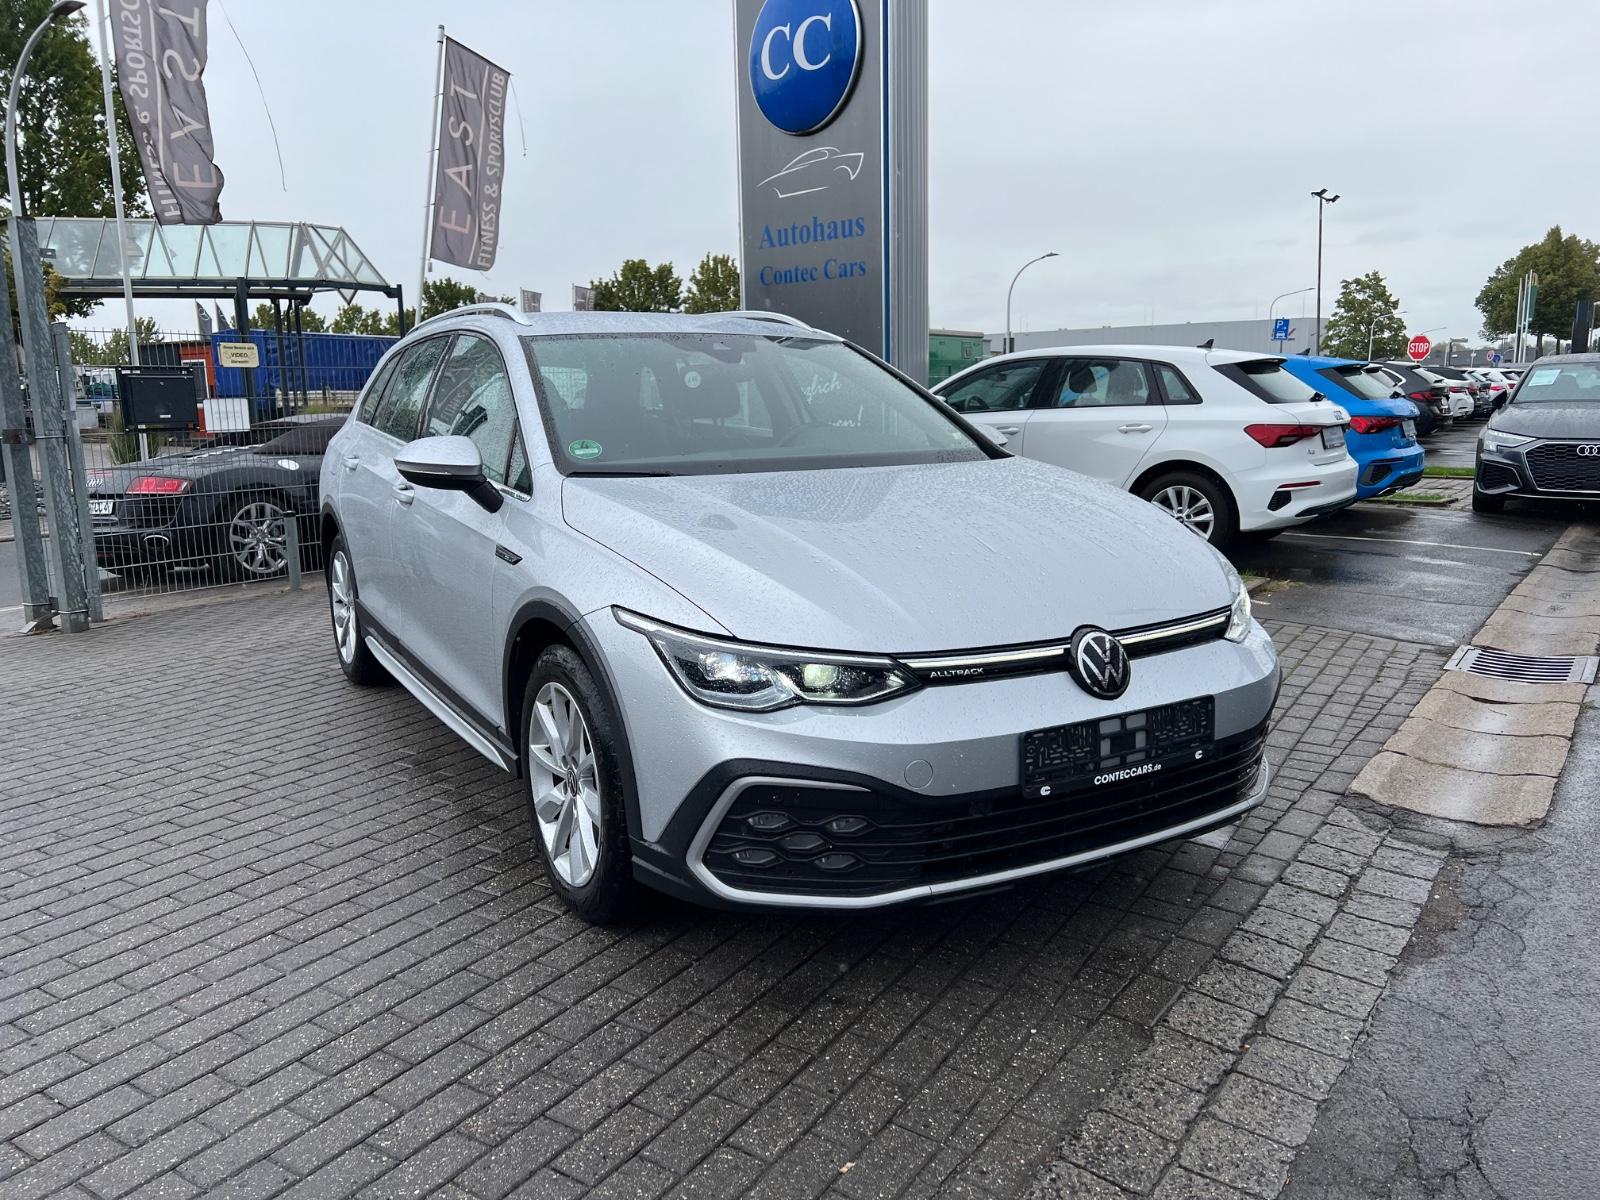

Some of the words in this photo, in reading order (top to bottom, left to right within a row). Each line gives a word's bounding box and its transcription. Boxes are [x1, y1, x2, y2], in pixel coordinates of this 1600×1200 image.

[760, 12, 832, 81] CC
[487, 72, 506, 177] SPORTSCLUB
[439, 82, 477, 235] EAST
[484, 183, 499, 197] &
[477, 202, 497, 268] FITNESS
[759, 216, 866, 250] Autohaus
[760, 265, 818, 287] Contec
[823, 258, 867, 280] Cars
[1276, 320, 1284, 329] P
[1410, 342, 1429, 353] STOP
[930, 667, 985, 679] ALLTRACK
[1094, 763, 1162, 785] CONTECCARS.de
